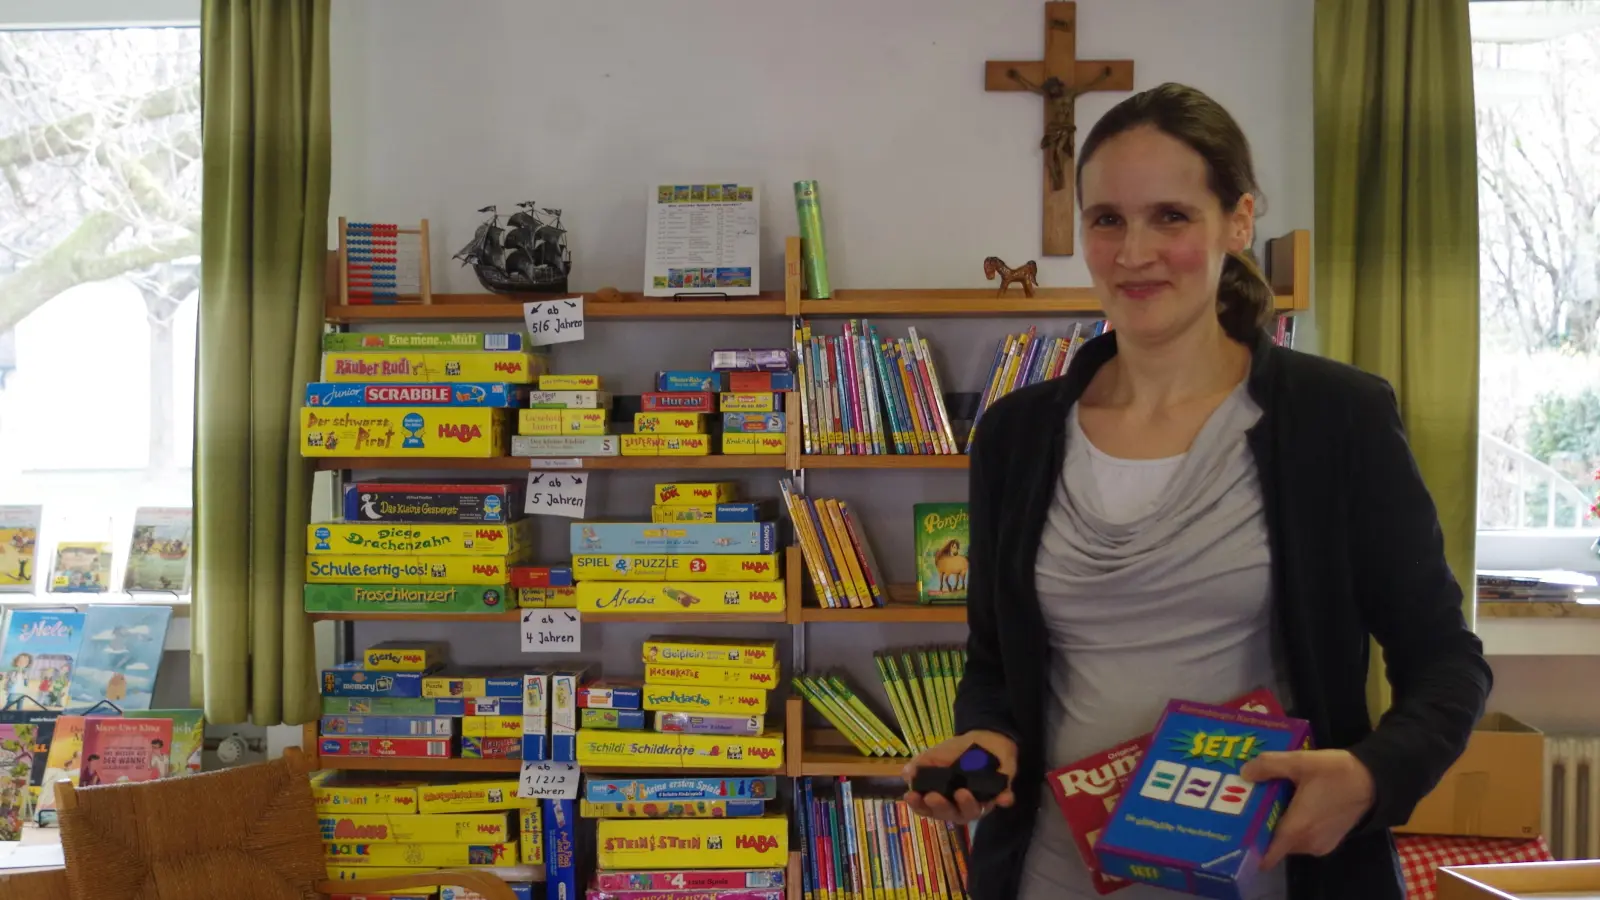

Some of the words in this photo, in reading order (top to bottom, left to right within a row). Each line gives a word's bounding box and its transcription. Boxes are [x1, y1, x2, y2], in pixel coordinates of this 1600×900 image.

[547, 305, 559, 315] ab
[554, 318, 583, 333] Jahren
[335, 359, 379, 376] Räuber
[381, 358, 410, 375] Rudi
[494, 361, 522, 374] HABA
[322, 385, 363, 405] junior
[368, 387, 449, 401] SCRABBLE
[307, 412, 330, 428] Der
[332, 413, 392, 428] schwarze
[675, 419, 694, 428] HABA
[354, 427, 396, 450] Pirat
[438, 423, 482, 443] HABA
[681, 438, 703, 448] HABA
[762, 439, 783, 447] HABA
[548, 477, 561, 487] ab
[693, 488, 712, 497] HABA
[531, 492, 543, 504] 5
[547, 493, 584, 507] Jahren
[380, 503, 397, 514] Das
[377, 528, 421, 540] Diego
[476, 529, 503, 542] HABA
[345, 532, 451, 551] Drachenzahn
[577, 558, 609, 567] SPIEL
[616, 559, 628, 569] &
[634, 558, 679, 568] PUZZLE
[742, 561, 769, 573] HABA
[310, 561, 361, 576] Schule
[363, 563, 428, 579] fertig-los!
[472, 564, 499, 576] HABA
[354, 587, 458, 604] Froschkonzert
[749, 591, 777, 603] HABA
[541, 614, 554, 624] ab
[525, 632, 534, 644] 4
[538, 632, 574, 645] Jahren
[403, 655, 422, 663] HABA
[745, 649, 766, 660] HABA
[750, 672, 771, 683] HABA
[343, 683, 376, 693] memory
[738, 696, 760, 706] HABA
[501, 721, 520, 730] HABA
[589, 741, 625, 754] Schildi
[630, 743, 695, 756] Schildkröte
[1189, 731, 1256, 760] SET!
[748, 747, 775, 760] HABA
[119, 757, 146, 765] WANNE
[527, 787, 565, 796] Jahren
[394, 796, 413, 805] HABA
[477, 823, 501, 834] HABA
[604, 836, 648, 851] STEIN
[658, 836, 701, 850] STEIN
[736, 835, 779, 853] HABA
[1129, 864, 1159, 879] SET!
[670, 873, 686, 890] 4
